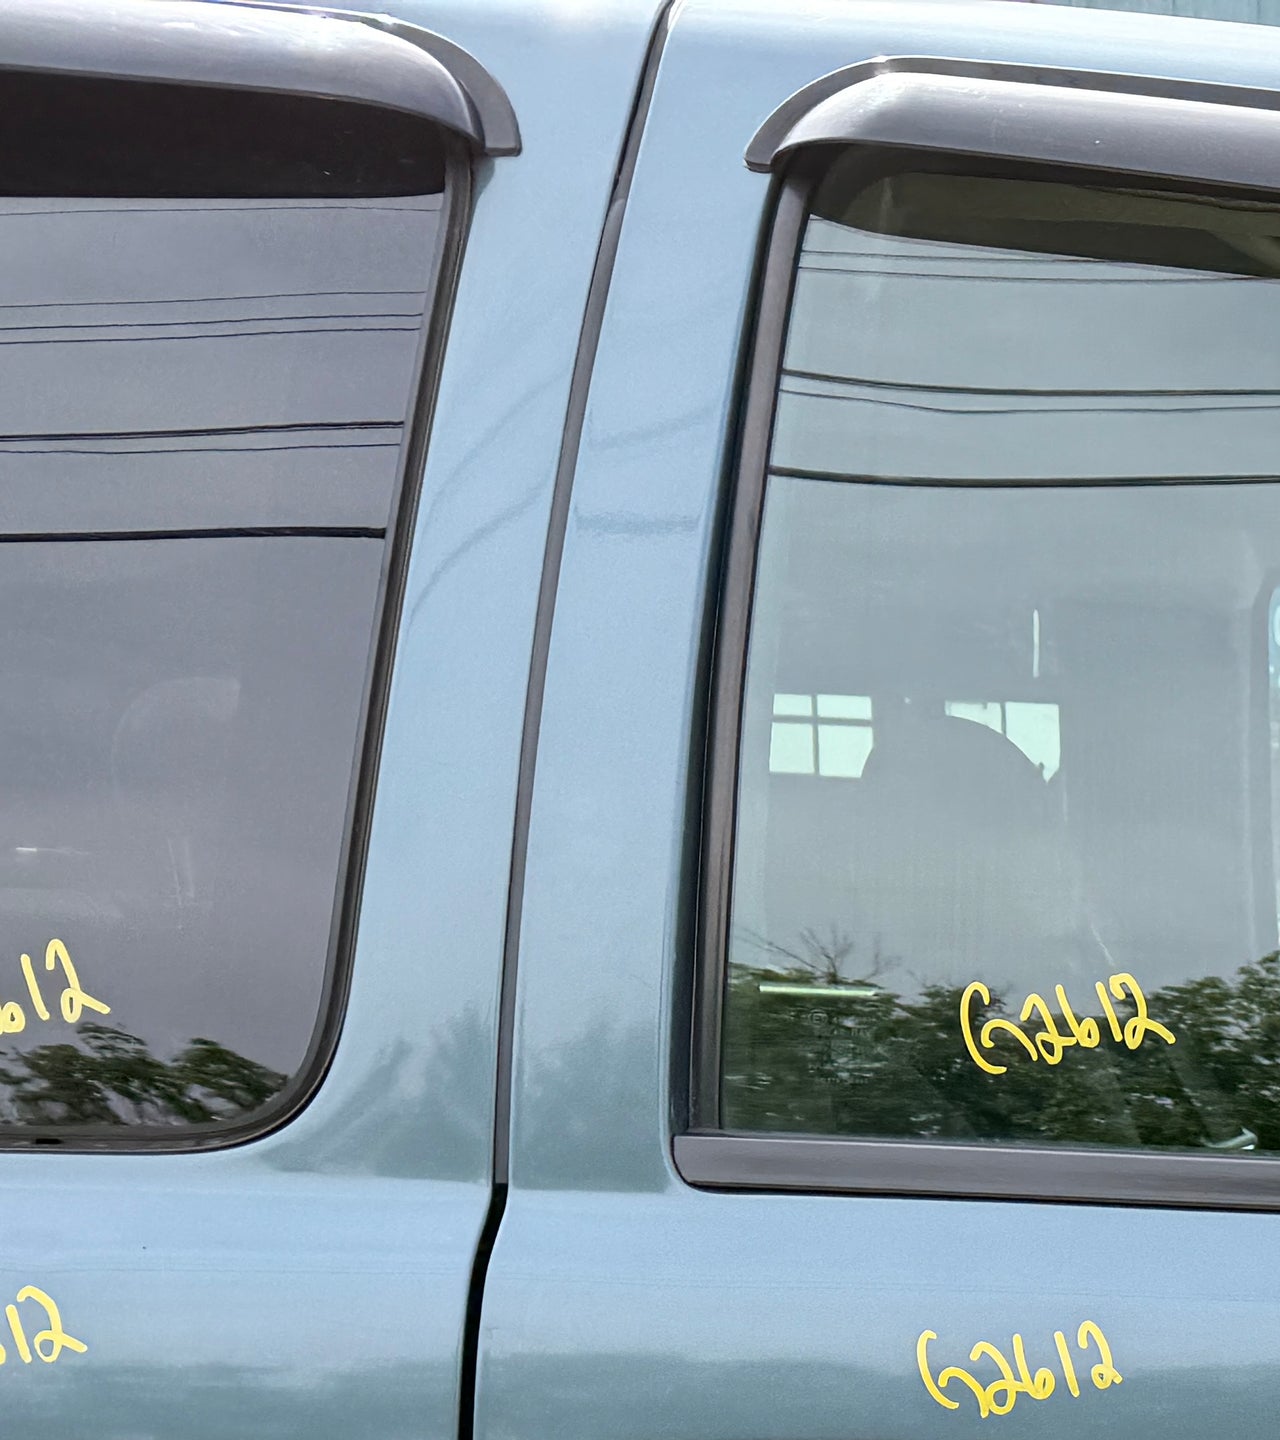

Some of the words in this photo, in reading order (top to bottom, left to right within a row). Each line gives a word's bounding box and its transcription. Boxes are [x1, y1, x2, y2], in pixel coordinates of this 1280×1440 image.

[960, 973, 1176, 1075] G2612
[0, 1286, 88, 1365] 12
[916, 1320, 1123, 1418] G2612
